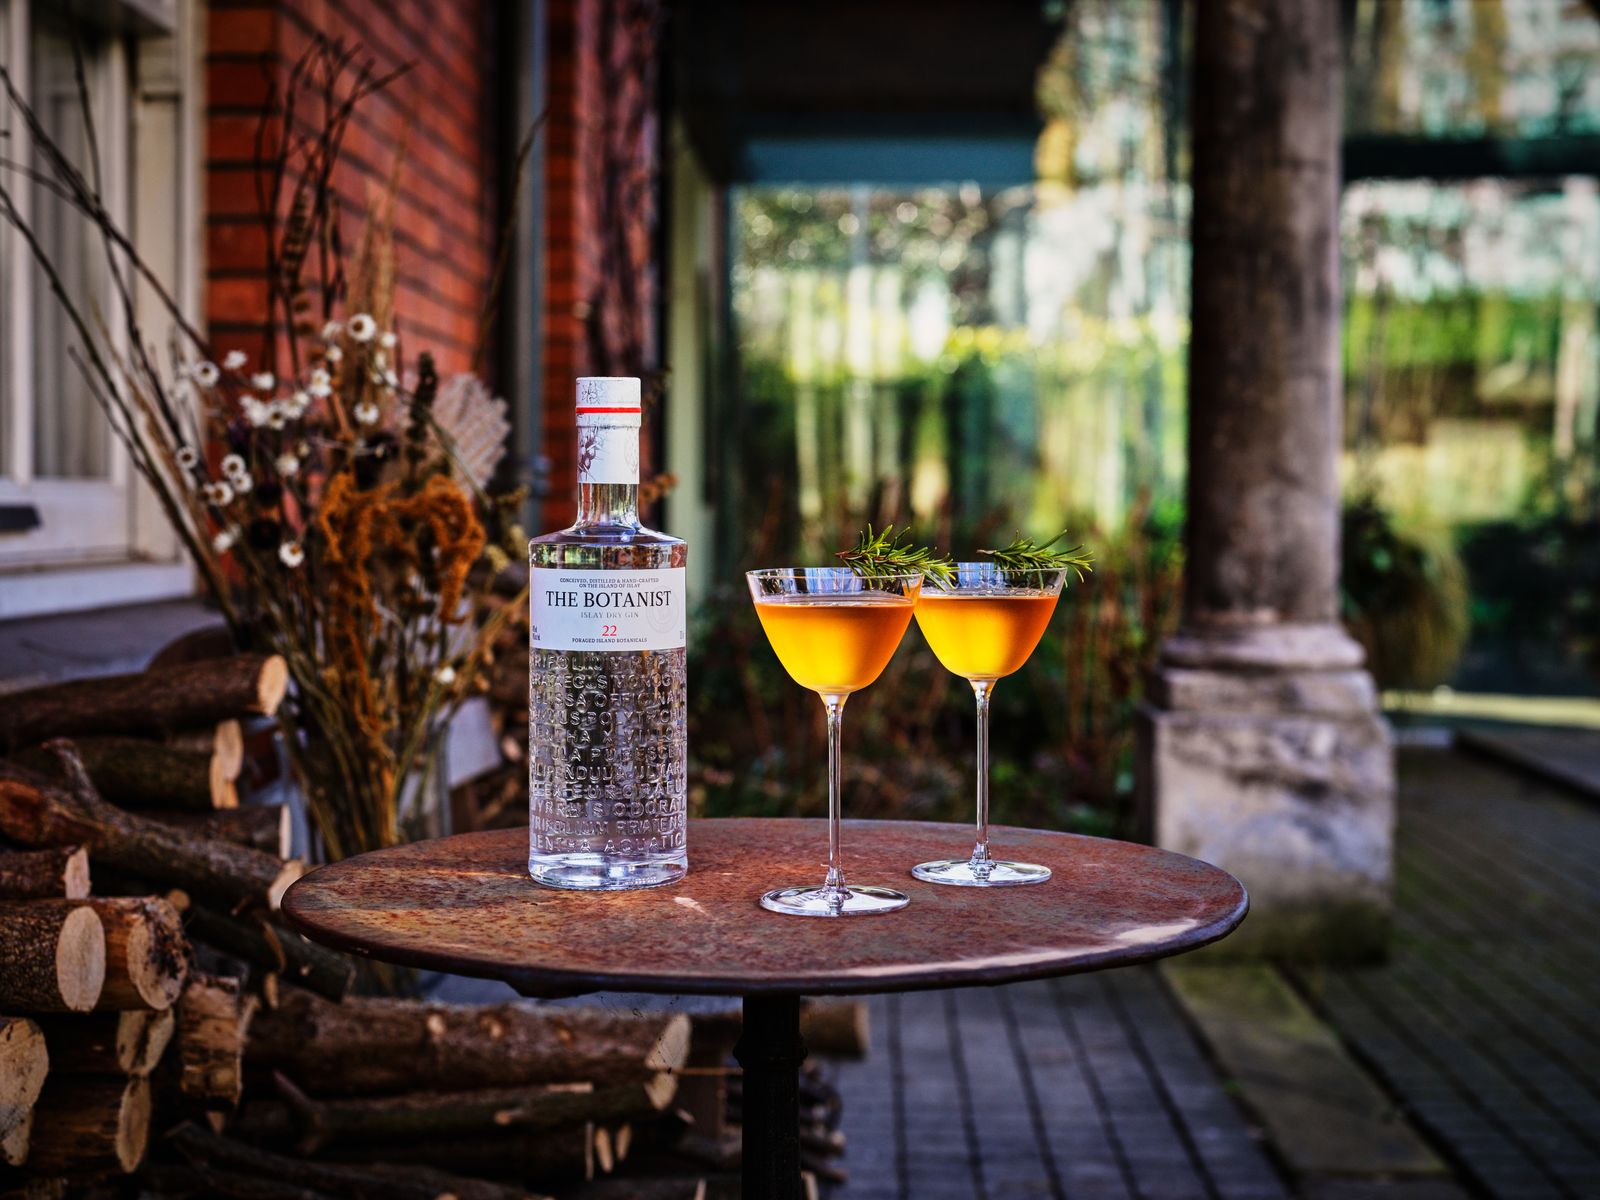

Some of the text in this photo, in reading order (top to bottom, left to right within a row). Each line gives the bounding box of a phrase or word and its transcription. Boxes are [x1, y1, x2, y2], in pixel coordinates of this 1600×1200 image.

[545, 590, 672, 608] THE BOTANIST
[580, 611, 639, 619] ISLAY DRY GIN
[601, 624, 618, 637] 22
